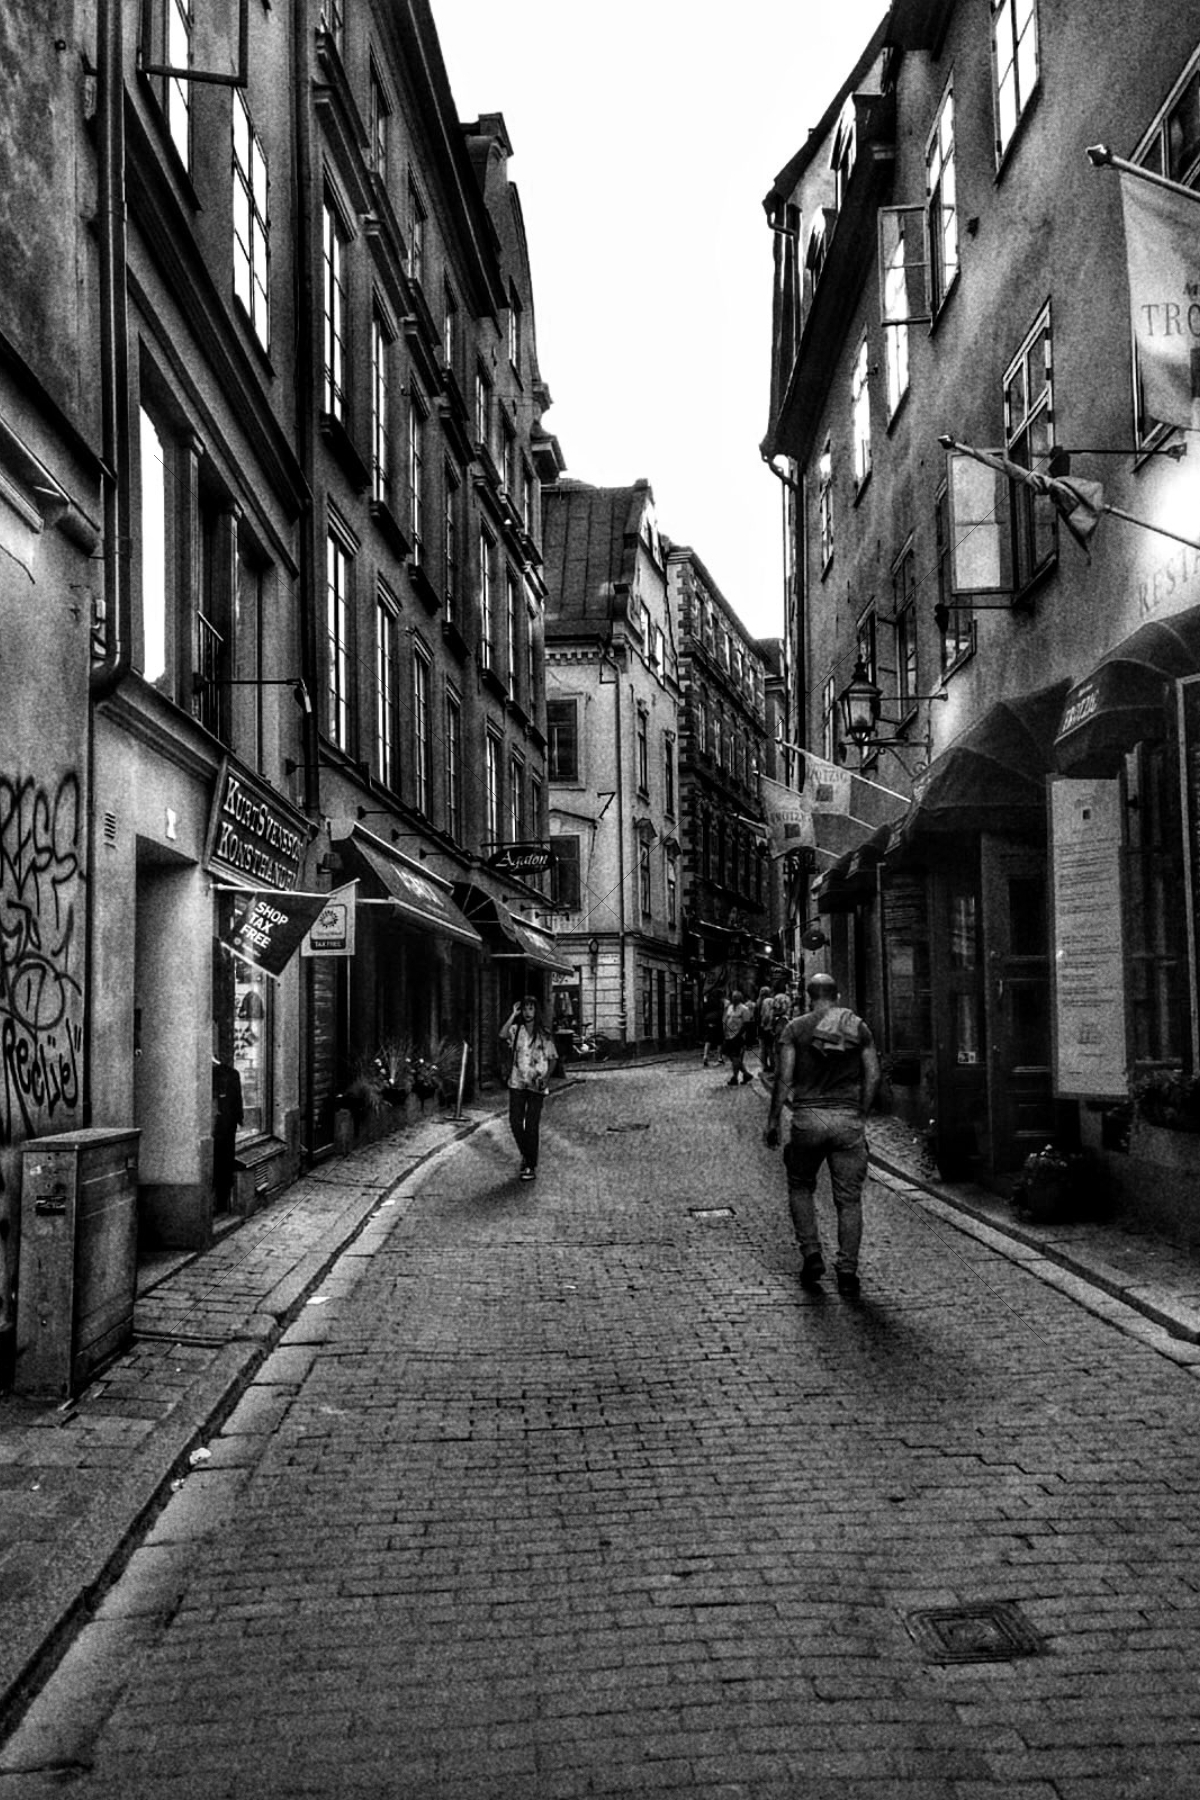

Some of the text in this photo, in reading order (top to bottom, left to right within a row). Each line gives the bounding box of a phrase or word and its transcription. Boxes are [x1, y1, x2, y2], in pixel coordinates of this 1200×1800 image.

[495, 849, 549, 872] Agaton
[248, 911, 275, 935] TAX
[254, 901, 289, 926] SHOP
[239, 923, 272, 950] FREE
